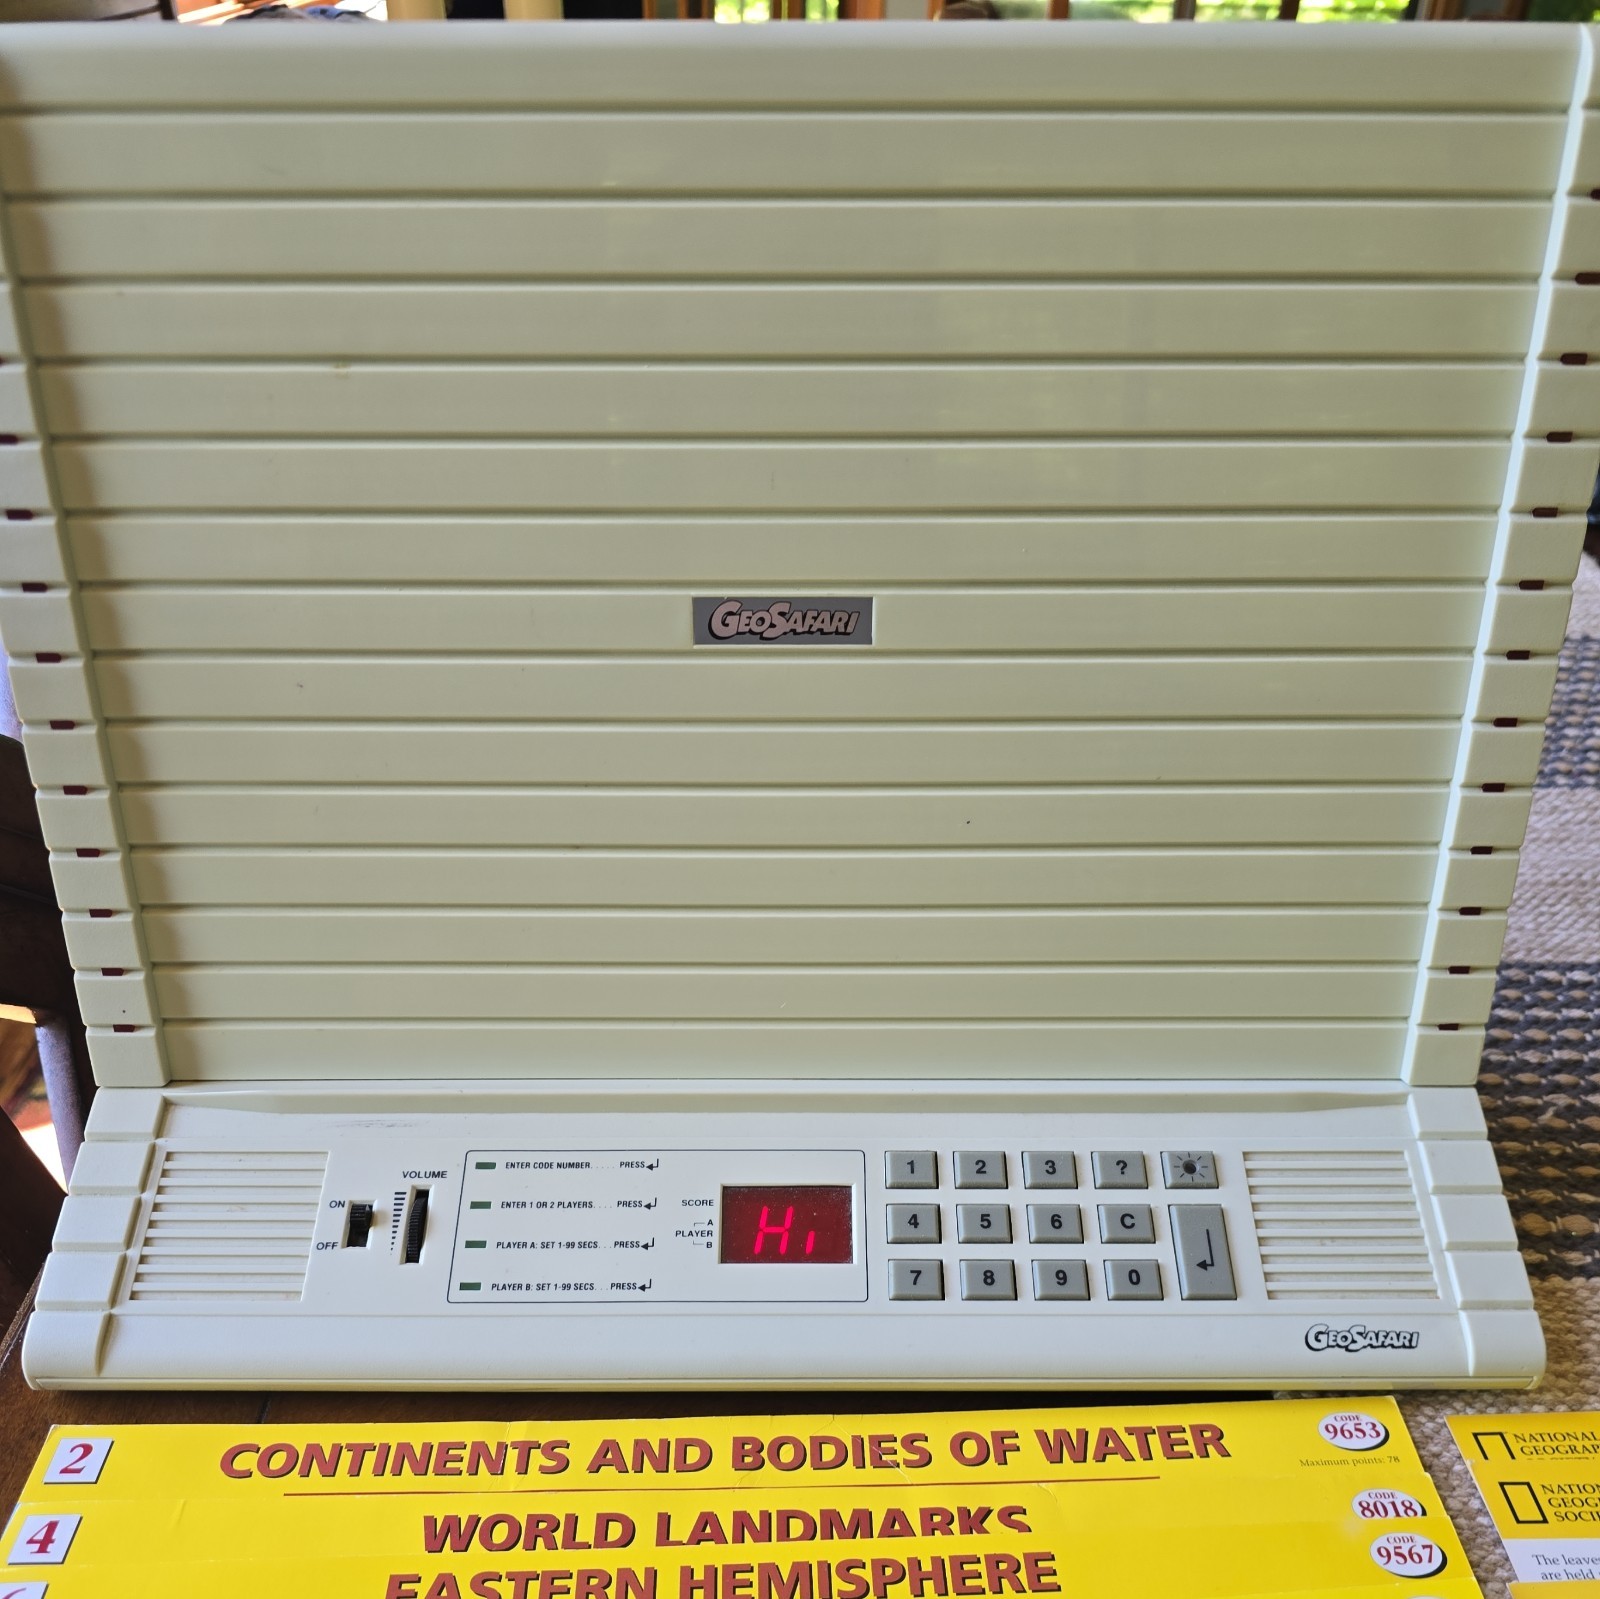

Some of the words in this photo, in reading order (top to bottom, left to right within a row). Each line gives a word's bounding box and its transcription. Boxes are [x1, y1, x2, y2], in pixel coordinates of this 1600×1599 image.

[505, 1161, 531, 1170] ENTER
[533, 1161, 554, 1170] CODE
[619, 1160, 645, 1169] PRESS
[906, 1159, 916, 1175] 1
[975, 1159, 987, 1175] 2
[1044, 1159, 1057, 1175] 3
[1115, 1159, 1128, 1175] ?
[402, 1170, 448, 1179] VOLUME
[329, 1200, 346, 1209] ON
[501, 1201, 527, 1209] ENTER
[529, 1201, 533, 1209] 1
[536, 1201, 548, 1209] OR
[549, 1201, 555, 1209] 2
[617, 1200, 643, 1208] PRESS
[681, 1199, 714, 1207] SCORE
[907, 1213, 920, 1229] 4
[980, 1213, 992, 1229] 5
[1051, 1213, 1063, 1229] 6
[1120, 1213, 1136, 1229] C
[675, 1230, 713, 1238] PLAYER
[316, 1241, 339, 1251] OFF
[496, 1241, 528, 1249] PLAYER
[540, 1241, 556, 1249] SET
[558, 1241, 576, 1249] 1-99
[613, 1241, 640, 1249] PRESS
[706, 1241, 713, 1249] B
[909, 1270, 922, 1285] 7
[983, 1270, 996, 1285] 8
[1055, 1270, 1068, 1286] 9
[1128, 1269, 1141, 1286] 0
[491, 1283, 523, 1291] PLAYER
[525, 1283, 533, 1291] B:
[535, 1283, 551, 1291] SET
[553, 1283, 572, 1291] 1-99
[610, 1282, 637, 1291] PRESS
[1333, 1414, 1362, 1422] CODE
[1324, 1421, 1381, 1440] 9653
[1513, 1431, 1599, 1444] NATIONAL
[220, 1440, 570, 1478] CONTINENTS
[586, 1437, 713, 1474] AND
[731, 1433, 932, 1471] BODIES
[949, 1430, 1020, 1467] OF
[1033, 1423, 1232, 1464] WATER
[59, 1443, 94, 1475] 2
[1299, 1458, 1350, 1467] Maximum
[1352, 1457, 1385, 1466] points:
[1387, 1455, 1400, 1463] 78
[1367, 1491, 1398, 1500] CODE
[1358, 1499, 1418, 1518] 8018
[423, 1512, 636, 1553] WORLD
[655, 1505, 1032, 1547] LANDMARKS
[26, 1520, 60, 1554] 4
[1386, 1535, 1417, 1544] CODE
[1376, 1544, 1433, 1565] 9567
[1532, 1555, 1560, 1566] The
[385, 1567, 657, 1599] EASTERN
[679, 1551, 1062, 1599] HEMISPHERE
[1541, 1571, 1562, 1580] are
[1564, 1569, 1595, 1580] held
